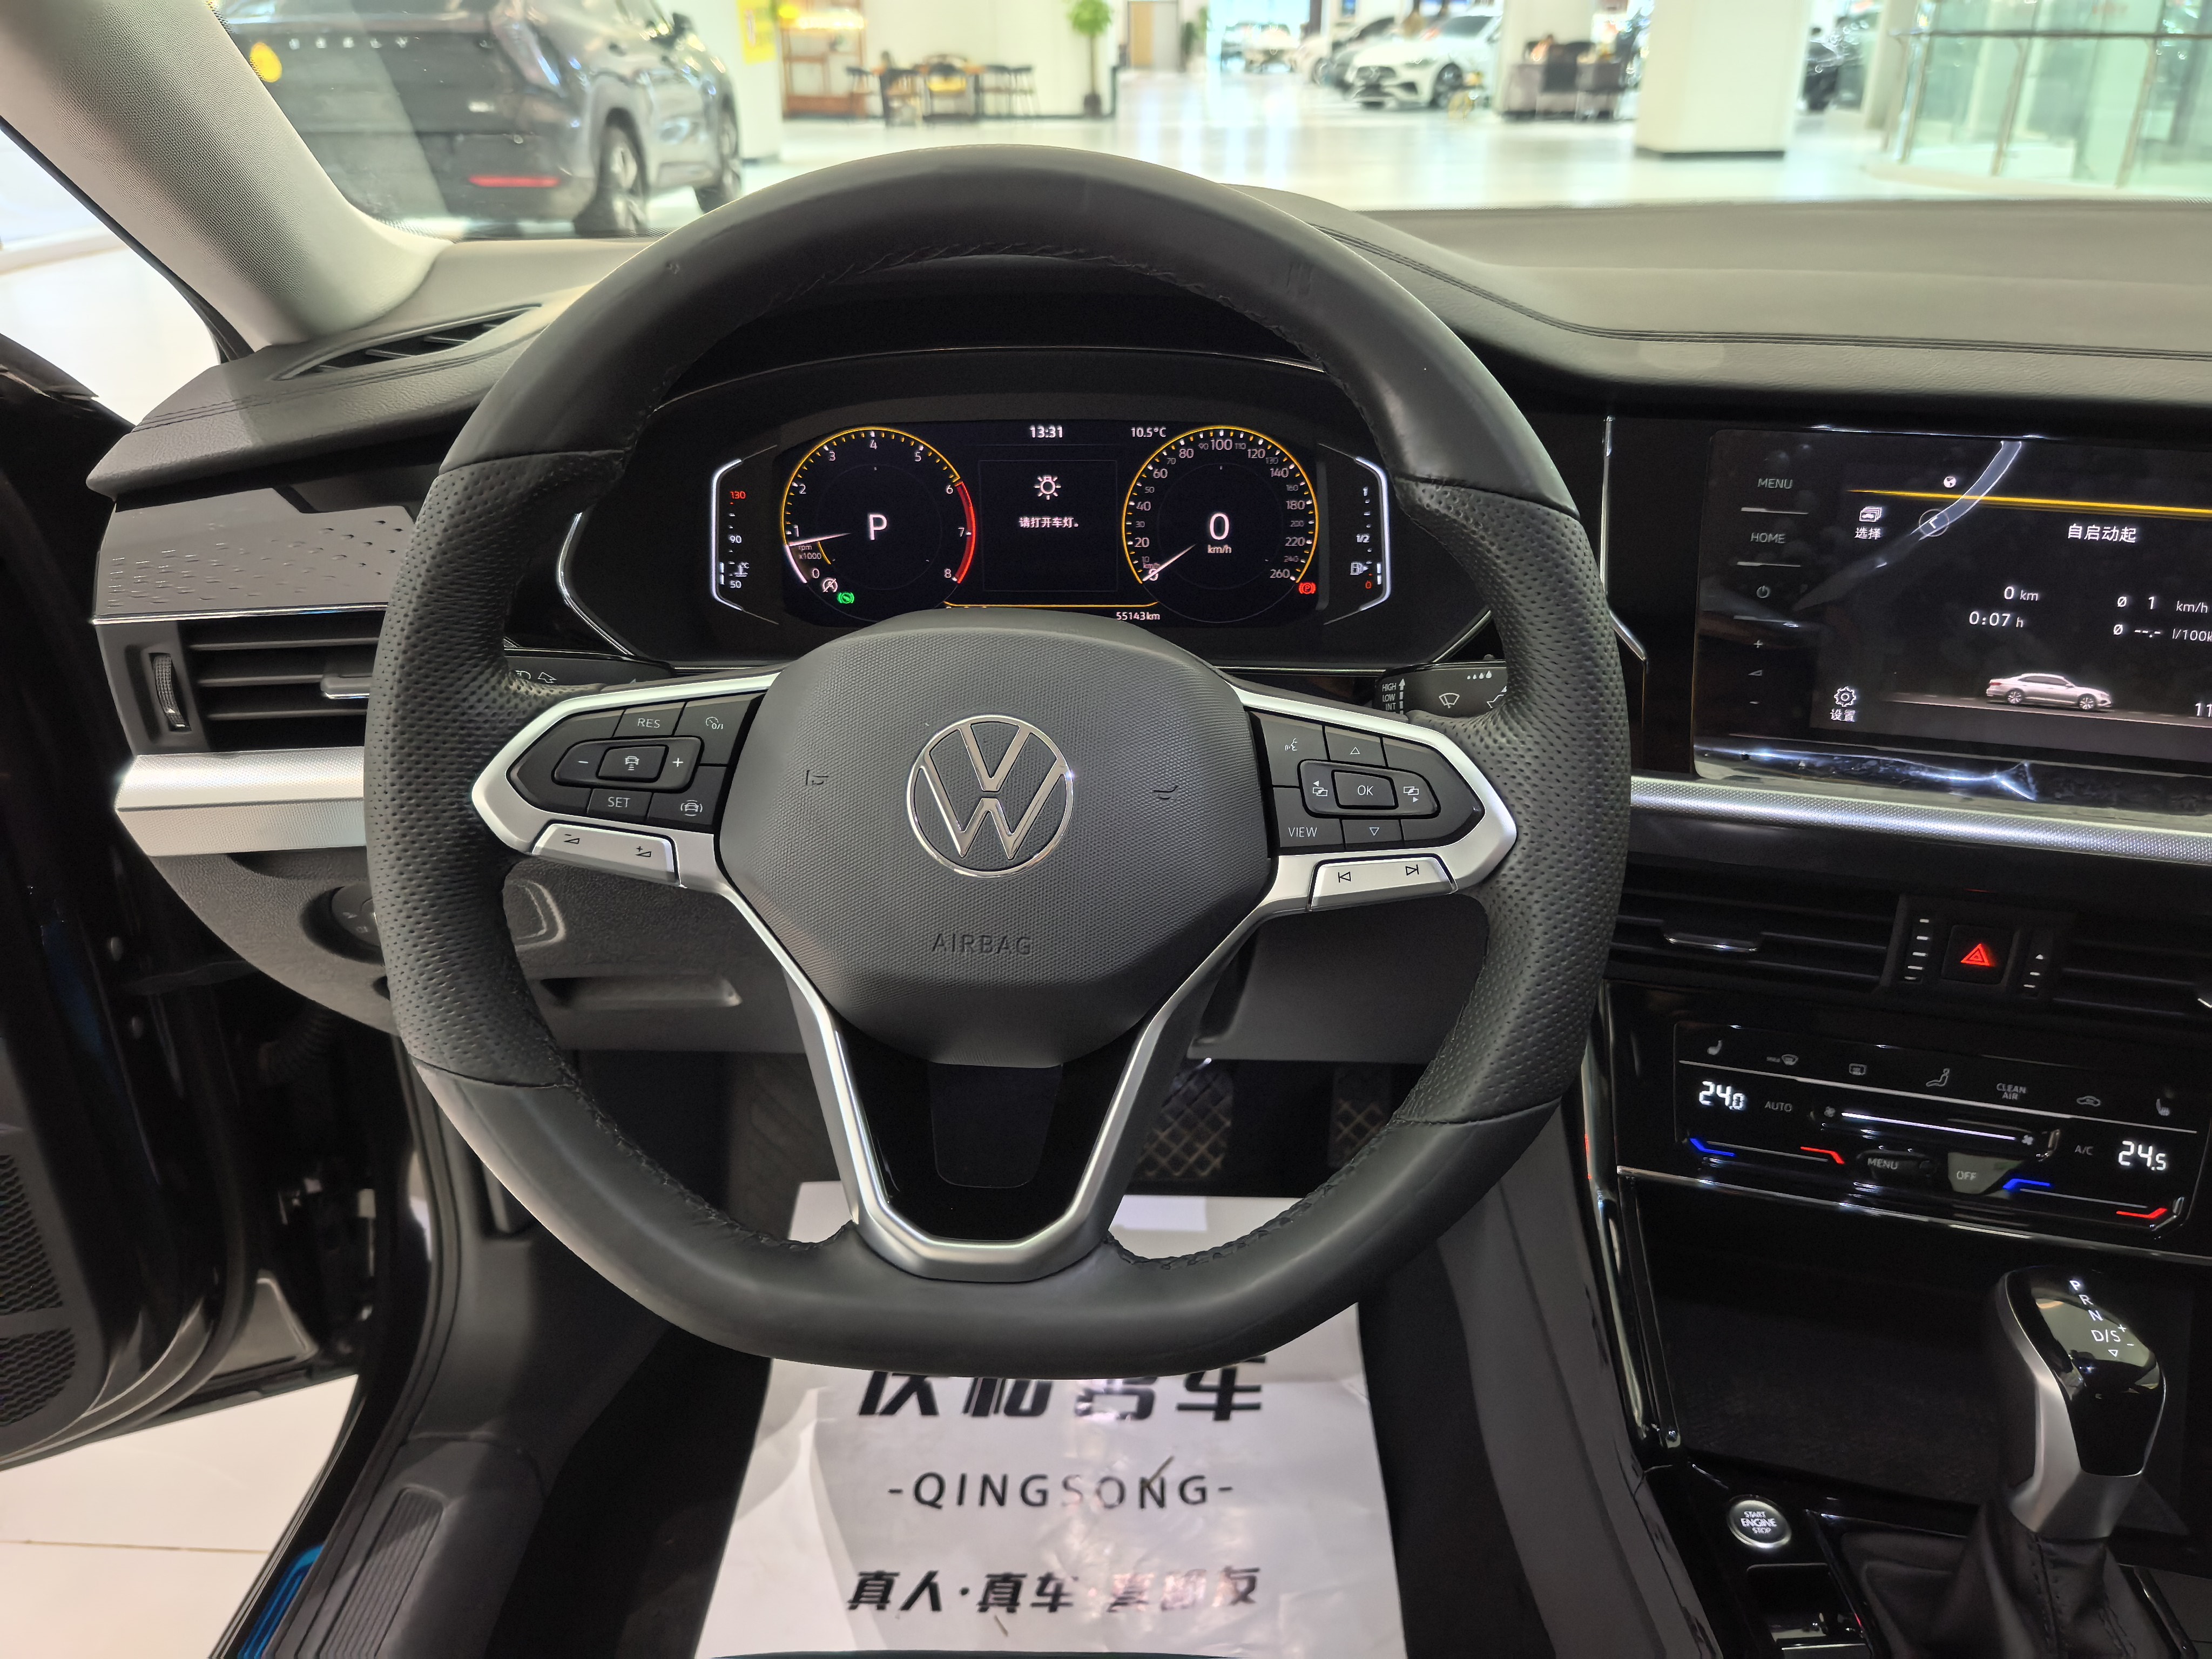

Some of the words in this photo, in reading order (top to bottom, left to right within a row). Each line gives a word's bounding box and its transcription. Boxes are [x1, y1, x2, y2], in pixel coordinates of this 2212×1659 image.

[1029, 424, 1063, 438] 13:31
[1130, 426, 1166, 437] 10.5°C
[870, 440, 877, 450] 4
[1210, 439, 1233, 450] 100
[828, 451, 836, 461] 3
[915, 451, 921, 461] 5
[1178, 448, 1194, 458] 80
[1247, 448, 1266, 458] 120
[1152, 468, 1168, 478] 60
[1270, 468, 1289, 477] 140
[799, 484, 806, 494] 2
[1758, 477, 1793, 490] MENU
[730, 490, 747, 500] 130
[946, 485, 953, 495] 6
[1136, 501, 1151, 511] 40
[869, 514, 888, 541] P
[1019, 516, 1079, 528] 请打开车灯。
[1209, 512, 1230, 541] 0
[794, 524, 799, 537] 1
[958, 528, 965, 537] 7
[1854, 527, 1882, 541] 选择
[2067, 523, 2137, 543] 自启动起
[729, 535, 743, 544] 90
[1134, 537, 1150, 548] 20
[1284, 537, 1305, 547] 220
[1751, 531, 1786, 544] HOME
[1207, 544, 1232, 554] km/h
[812, 568, 820, 579] 0
[944, 569, 952, 578] 8
[1270, 568, 1291, 578] 260
[730, 579, 743, 589] 50
[2004, 585, 2015, 601] 0
[2020, 589, 2039, 602] km
[2148, 596, 2155, 610] 1
[2176, 600, 2208, 613] km/h
[1968, 610, 2011, 628] 0:07
[2016, 616, 2025, 628] h
[1382, 683, 1397, 692] HIGH
[1382, 693, 1395, 702] LOW
[1385, 703, 1397, 711] INT
[1830, 709, 1857, 723] 设置
[637, 717, 661, 729] RES
[1357, 785, 1374, 797] OK
[608, 797, 631, 808] SET
[1287, 826, 1318, 838] VIEW
[931, 933, 1032, 955] AIRBAG
[1996, 1082, 2027, 1095] CLEAN
[1698, 1080, 1748, 1111] 24.0
[2002, 1091, 2019, 1102] AIR
[1764, 1101, 1793, 1113] AUTO
[2074, 1144, 2094, 1156] A/C
[2117, 1139, 2167, 1171] 24.5
[1867, 1157, 1900, 1171] MENU
[1955, 1171, 1977, 1181] OFF
[2069, 1279, 2081, 1291] P
[2079, 1294, 2094, 1306] R
[2088, 1310, 2103, 1321] N
